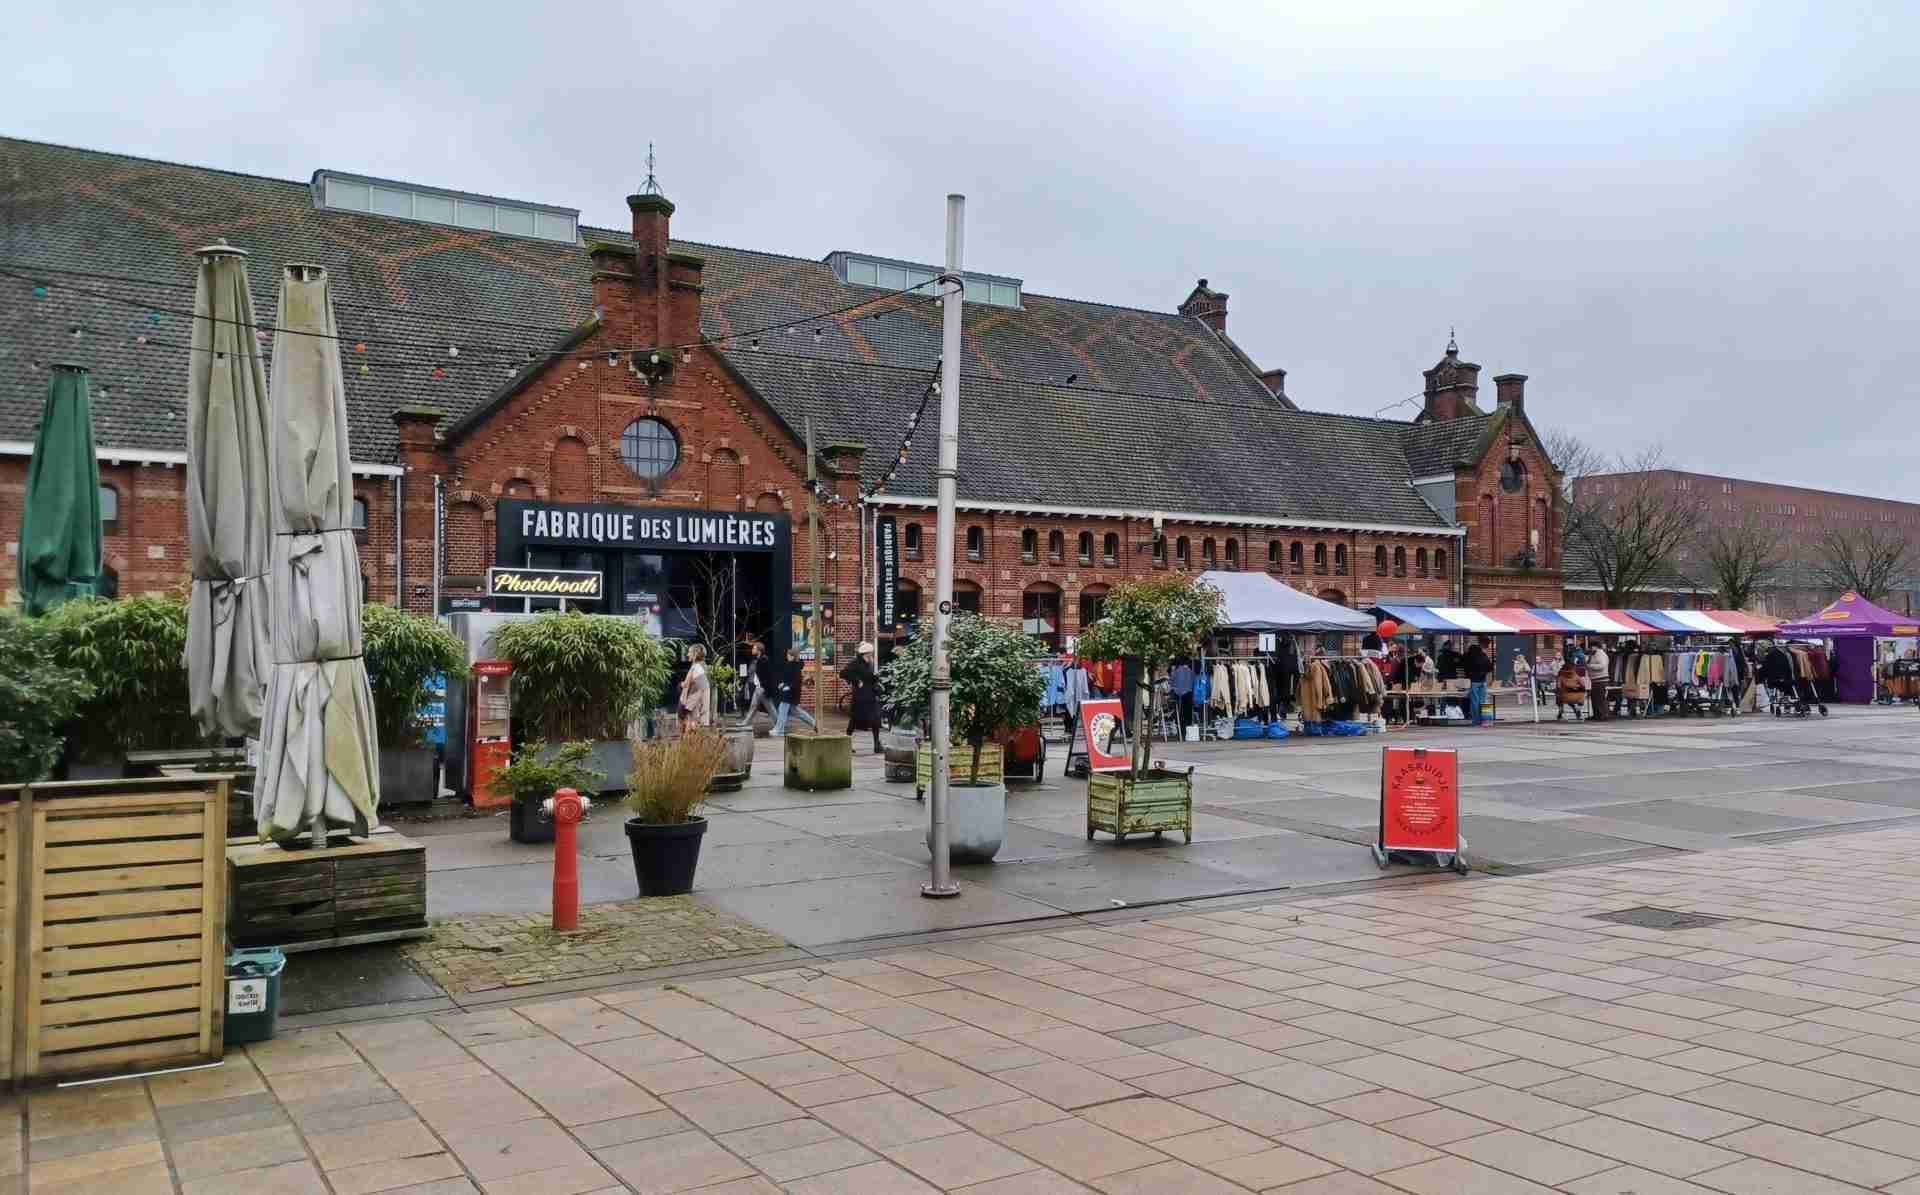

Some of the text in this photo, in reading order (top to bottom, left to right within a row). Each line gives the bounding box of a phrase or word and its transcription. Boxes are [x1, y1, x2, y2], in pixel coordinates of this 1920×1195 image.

[522, 509, 775, 546] FABRIQUE DES LUMIÈRES
[883, 523, 894, 568] FABRIQUE
[494, 573, 598, 594] Photobooth
